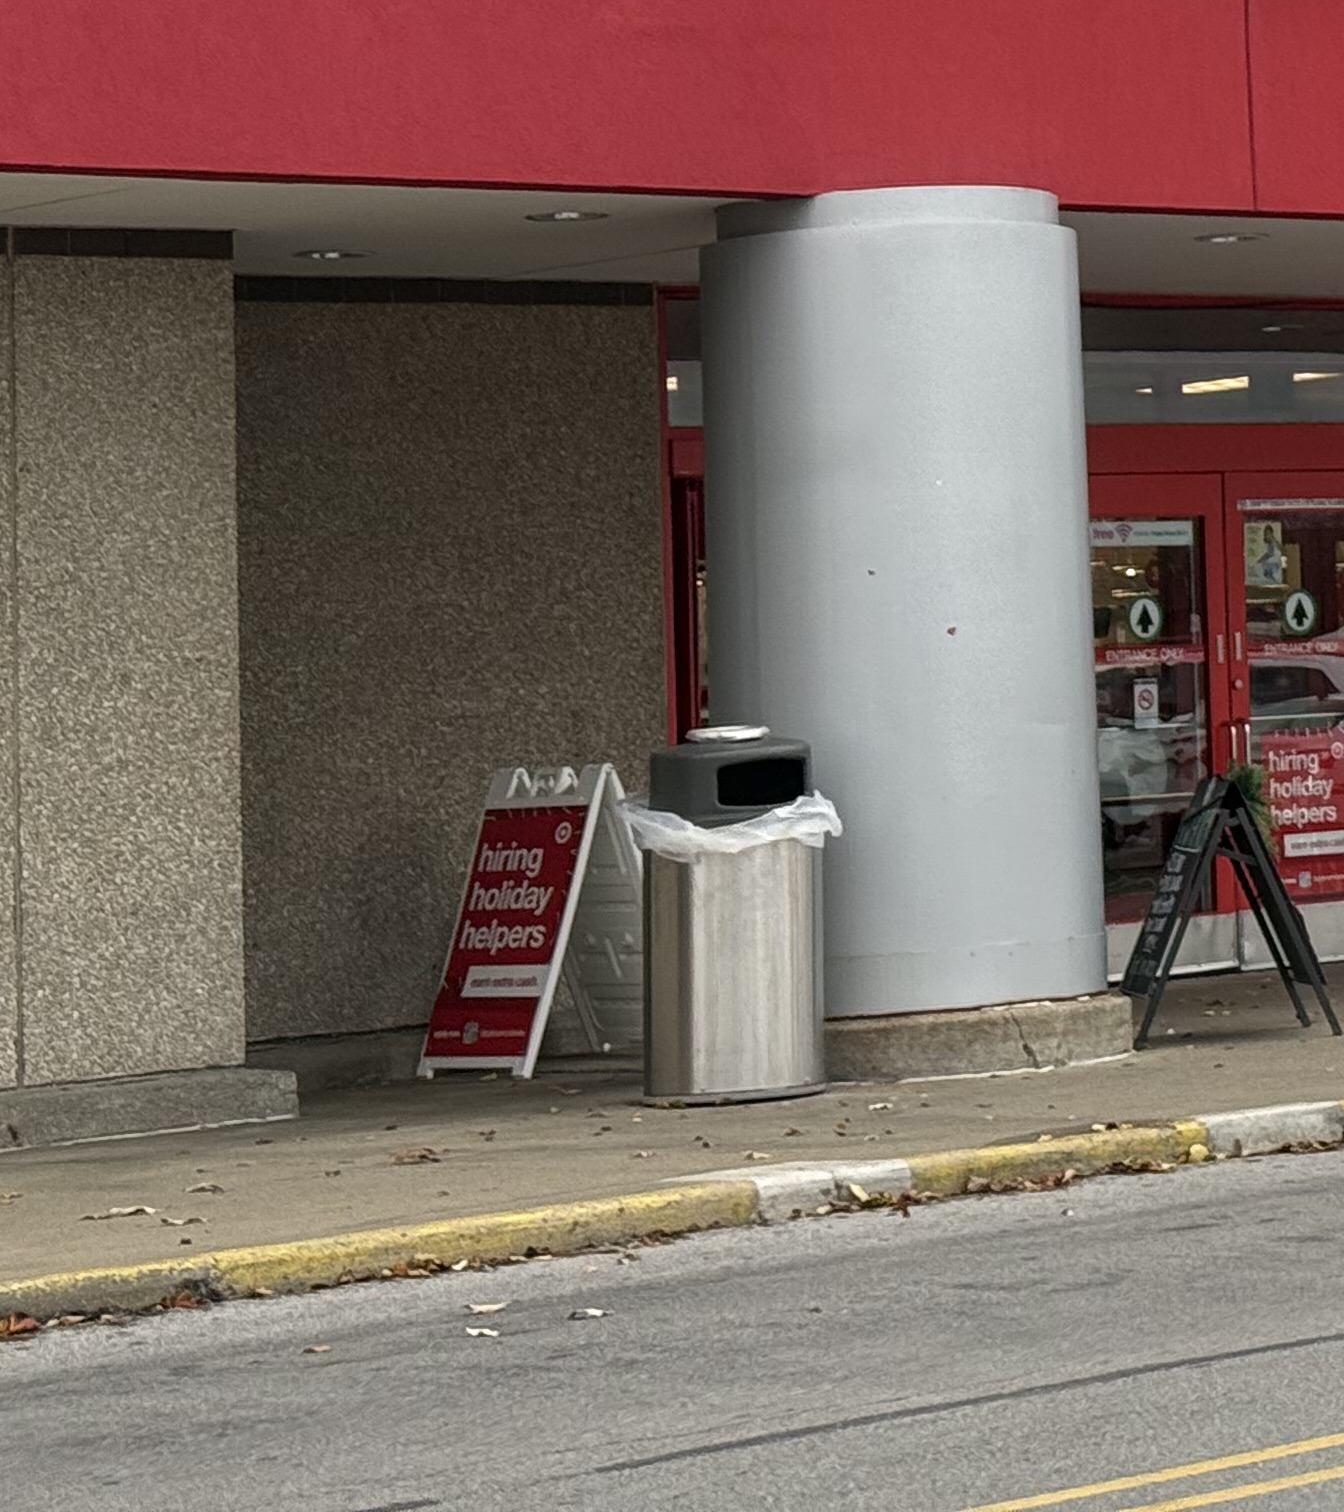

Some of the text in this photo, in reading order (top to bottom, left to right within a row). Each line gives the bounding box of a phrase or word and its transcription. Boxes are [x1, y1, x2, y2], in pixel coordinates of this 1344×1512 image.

[1268, 749, 1320, 775] hiring
[1269, 775, 1334, 800] holiday
[1270, 803, 1338, 829] helpers
[476, 841, 544, 878] hiring
[468, 879, 555, 916] holiday
[458, 918, 547, 956] helpers
